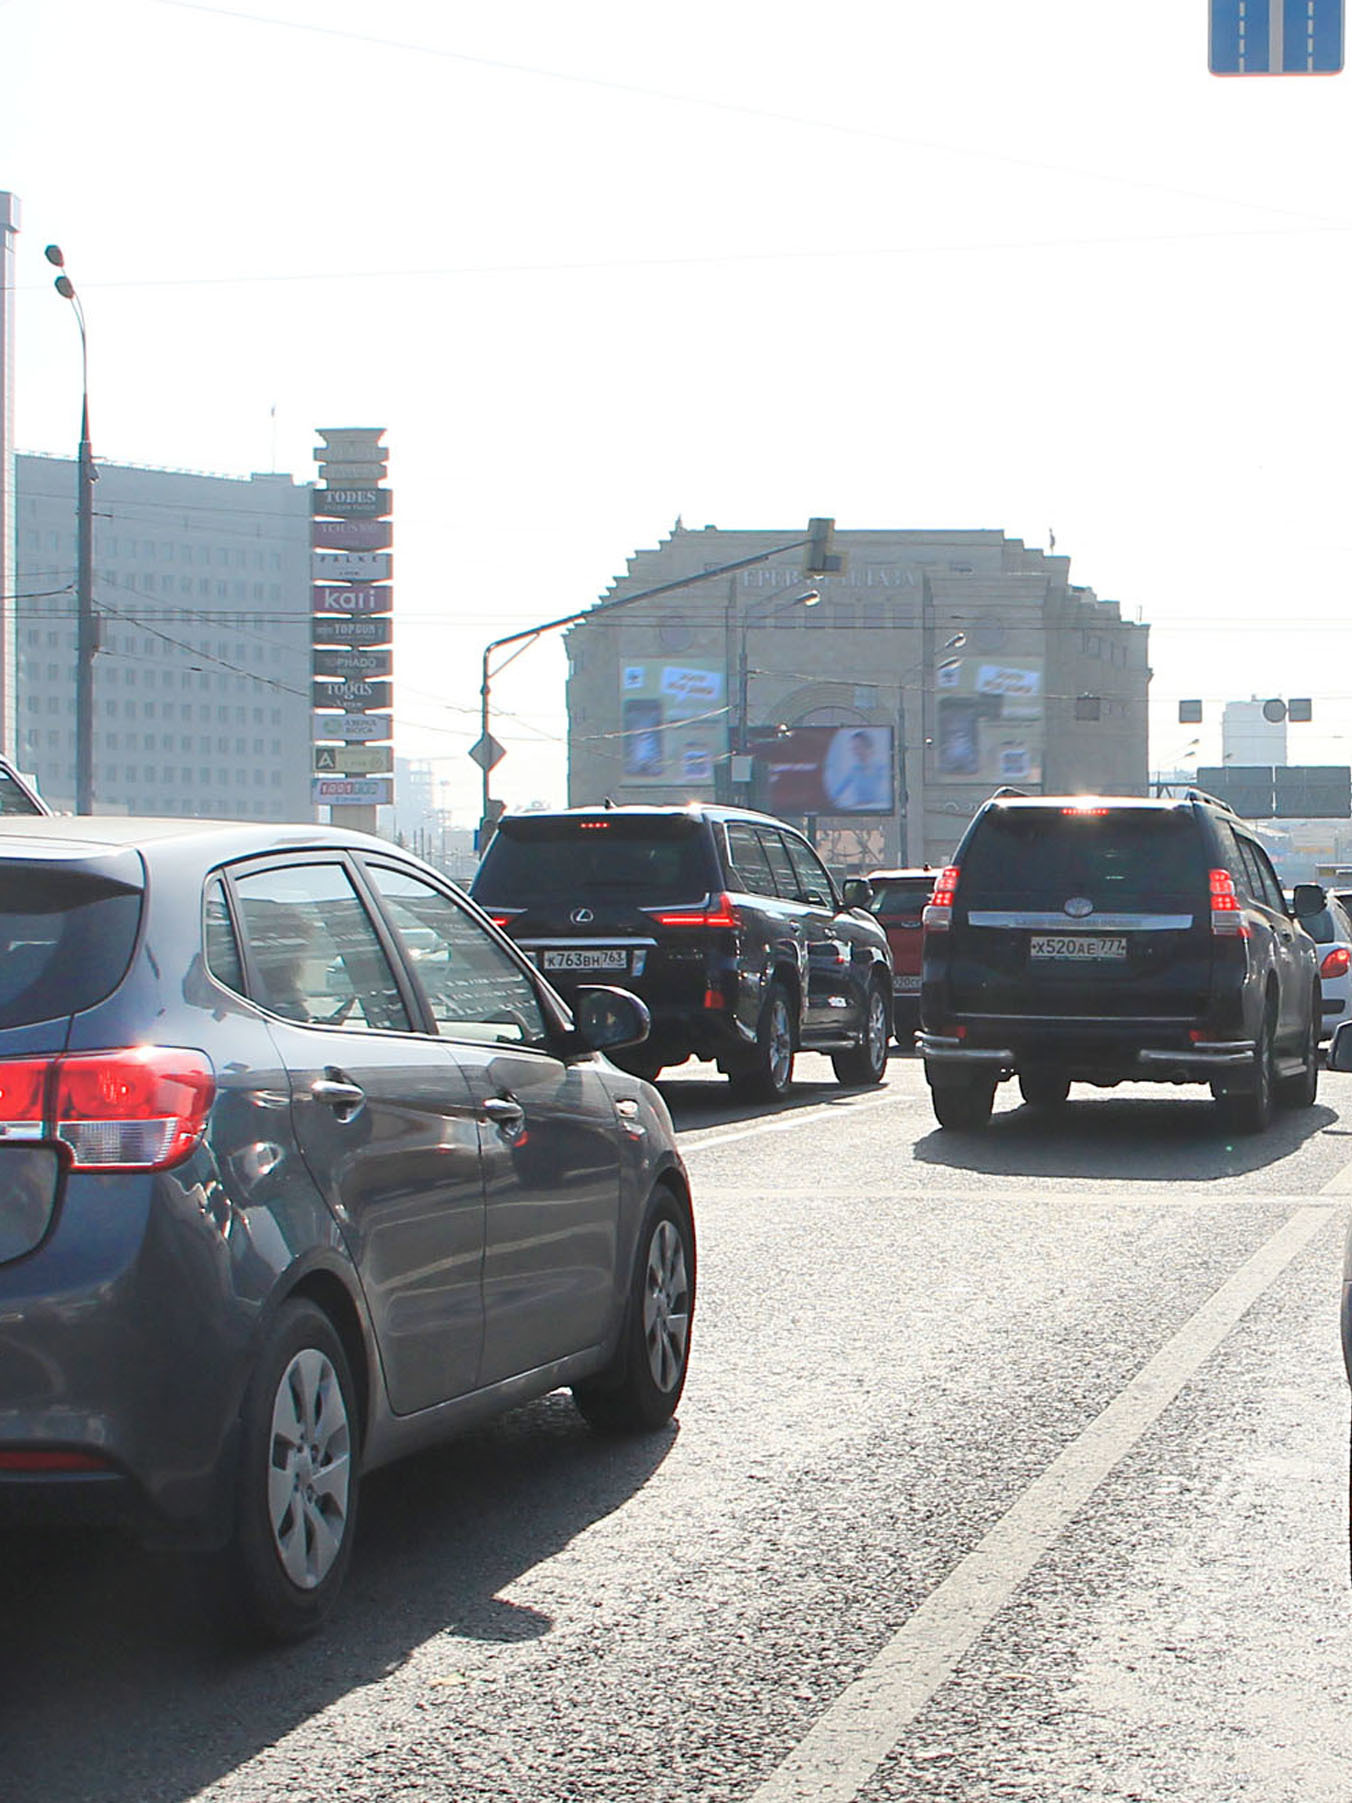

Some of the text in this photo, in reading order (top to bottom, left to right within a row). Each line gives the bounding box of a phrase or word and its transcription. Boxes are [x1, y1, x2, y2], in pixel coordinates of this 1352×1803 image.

[325, 491, 377, 503] TODES
[324, 588, 375, 609] kari
[1099, 939, 1122, 951] 777
